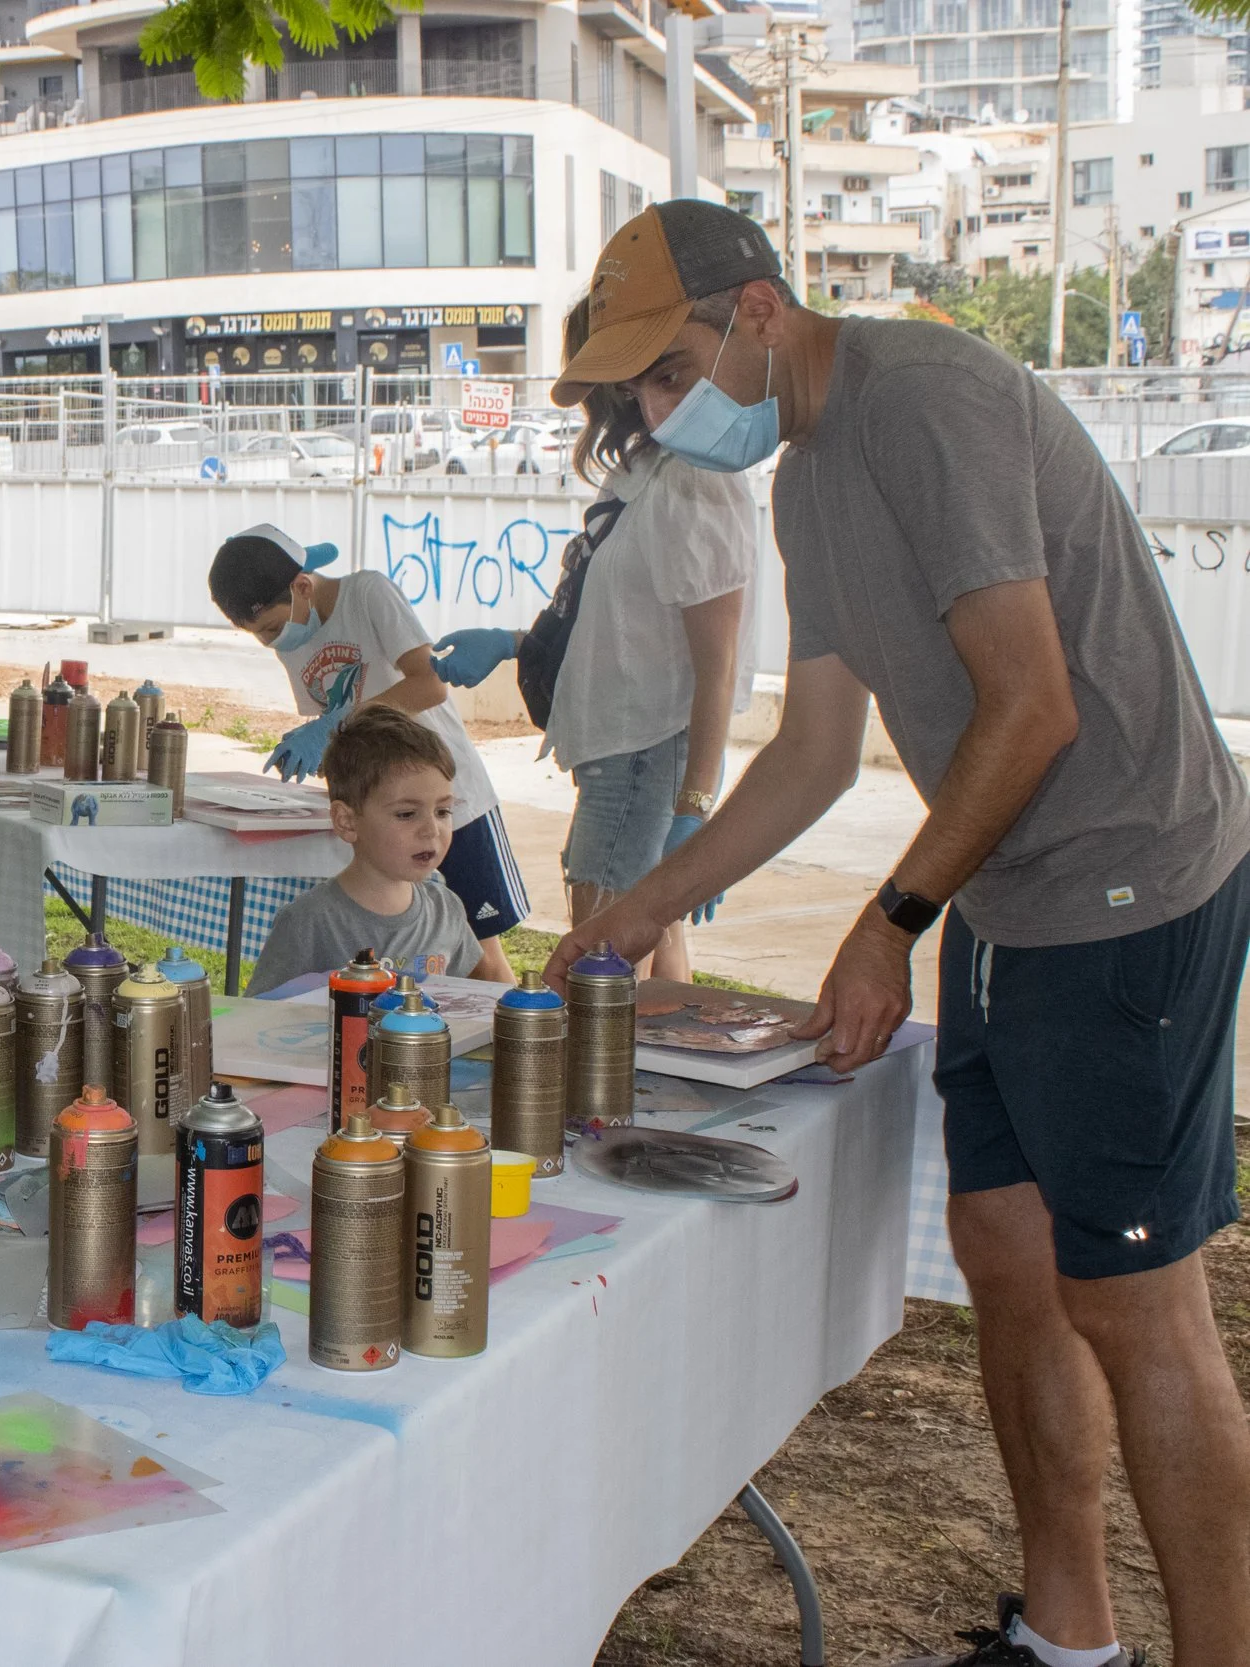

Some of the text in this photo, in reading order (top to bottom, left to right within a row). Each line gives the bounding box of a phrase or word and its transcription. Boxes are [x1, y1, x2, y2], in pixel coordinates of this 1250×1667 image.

[219, 314, 262, 333] בורגר
[299, 310, 333, 331] תומר
[401, 307, 444, 327] בורגר
[477, 306, 504, 325] תומר
[468, 394, 505, 410] סכנה!
[465, 411, 507, 426] כאן בונים
[302, 646, 362, 684] DOLPHINS
[108, 729, 117, 765] GOLD
[475, 908, 500, 920] adidas
[154, 1048, 169, 1119] GOLD
[435, 1187, 444, 1249] NC-ACRYLIC
[182, 1165, 199, 1297] www.kanvas.co.il
[415, 1212, 435, 1301] GOLD
